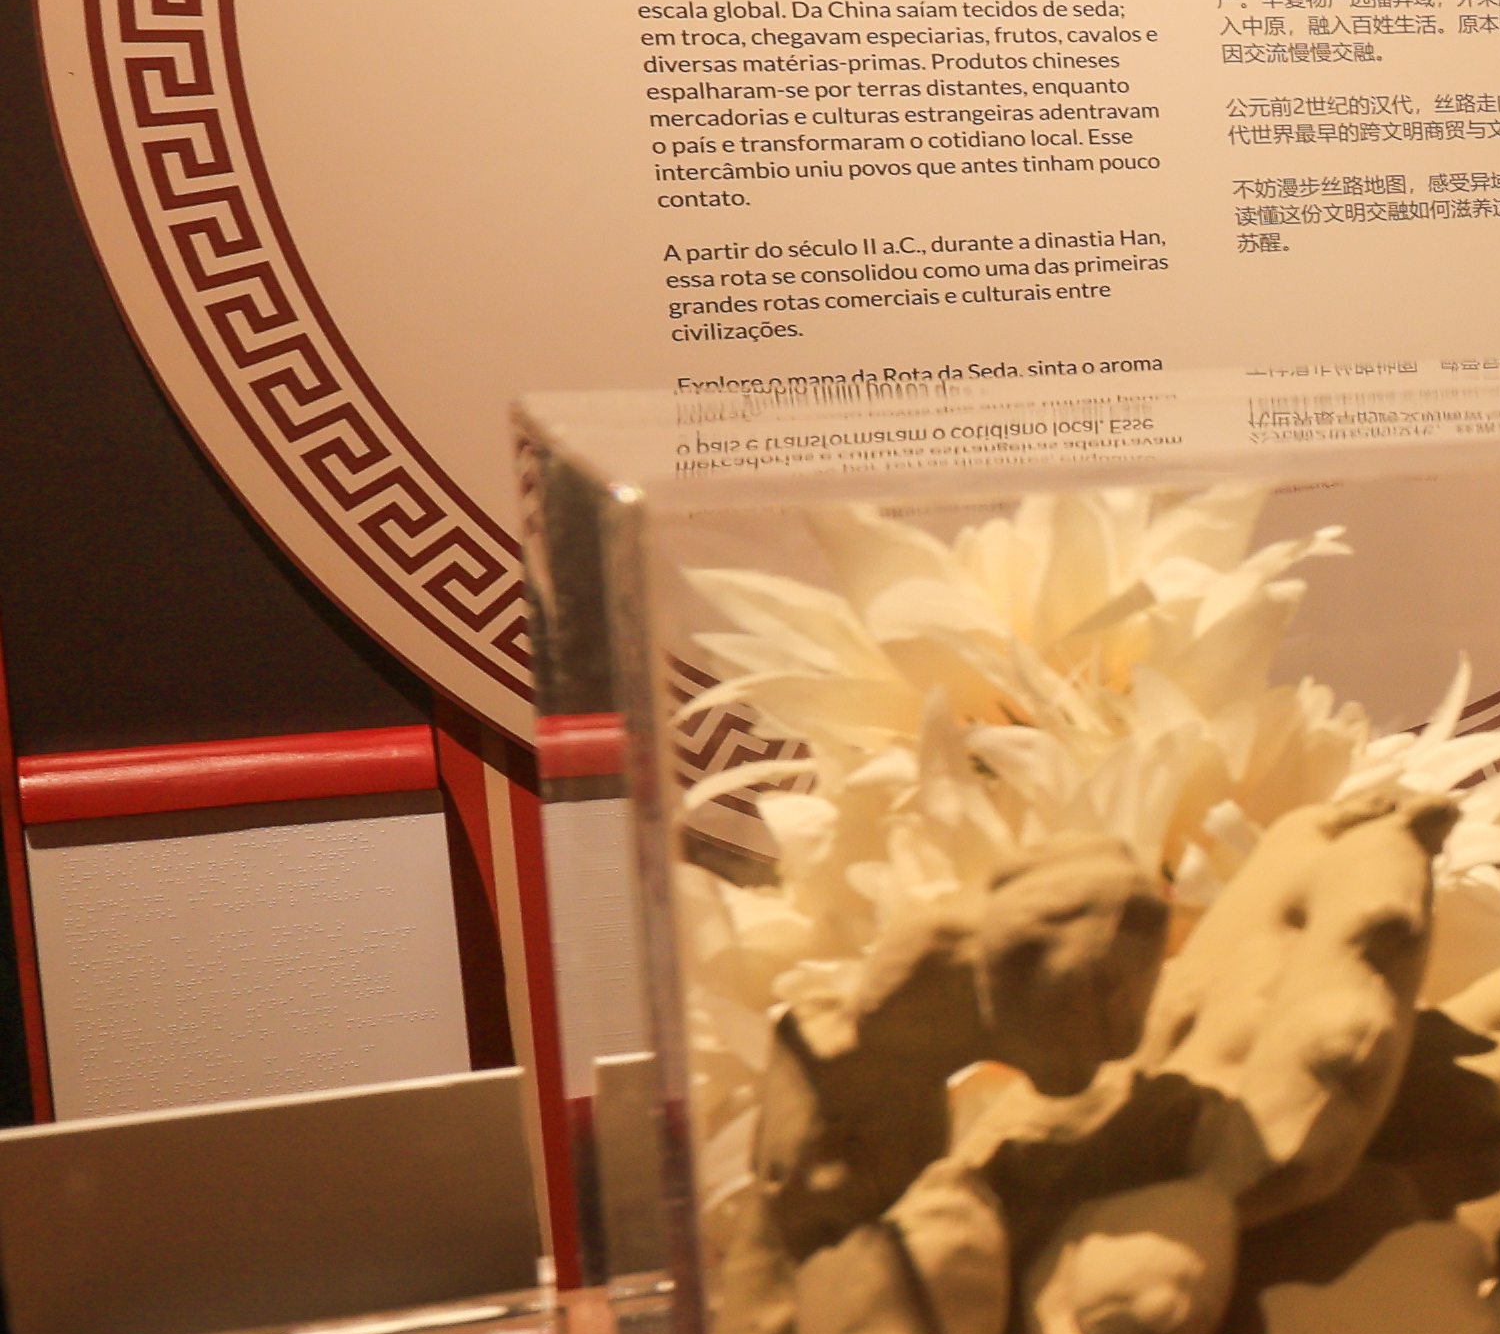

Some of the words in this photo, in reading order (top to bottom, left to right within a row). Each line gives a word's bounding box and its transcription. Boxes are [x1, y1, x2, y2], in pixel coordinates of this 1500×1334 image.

[664, 245, 682, 261] A
[686, 243, 749, 265] partir
[755, 241, 783, 258] do
[788, 239, 857, 257] século
[864, 238, 876, 255] II
[883, 237, 926, 255] a.C.,
[931, 235, 1013, 252] durante
[1019, 238, 1030, 249] a
[1035, 231, 1114, 249] dinastia
[1120, 230, 1166, 246] Han,
[666, 275, 715, 288] essa
[720, 270, 766, 286] rota
[772, 272, 796, 285] se
[800, 263, 918, 283] consolidou
[923, 265, 980, 279] como
[986, 263, 1030, 276] uma
[1034, 258, 1070, 274] das
[1074, 255, 1168, 276] primeiras
[669, 295, 758, 319] grandes
[764, 295, 820, 311] rotas
[825, 288, 940, 309] comerciais
[944, 292, 957, 303] e
[962, 284, 1051, 303] culturais
[1056, 283, 1110, 299] entre
